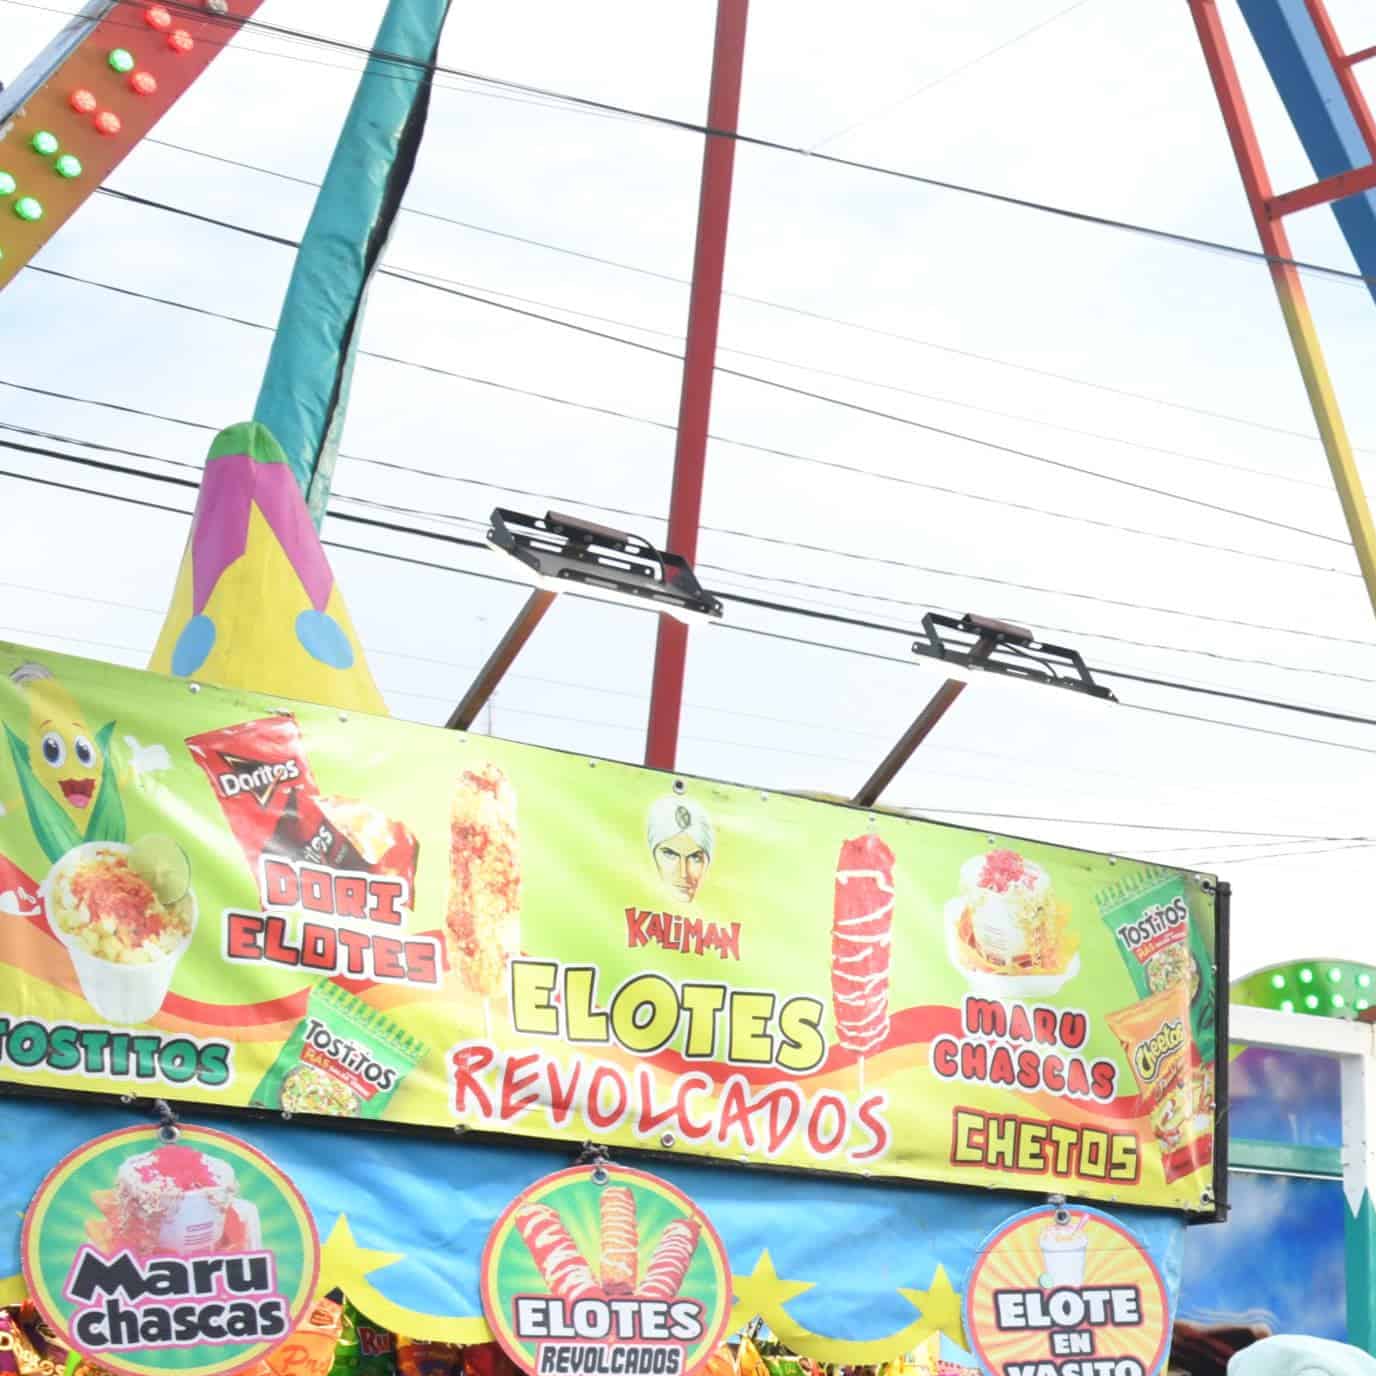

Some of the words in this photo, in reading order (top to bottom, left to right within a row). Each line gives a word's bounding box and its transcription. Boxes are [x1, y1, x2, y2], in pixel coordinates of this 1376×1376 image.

[219, 760, 299, 796] Doritos
[264, 860, 402, 925] DORI
[227, 913, 437, 984] ELOTES
[511, 960, 825, 1071] ELOTES
[966, 997, 1086, 1049] MARU
[934, 1039, 1116, 1099] CHASCAS
[453, 1046, 889, 1158] REVOLCADOS
[952, 1110, 1138, 1181] CHETOS
[71, 1251, 269, 1302] Maru
[77, 1299, 286, 1346] chascas
[516, 1297, 704, 1341] ELOTES
[995, 1287, 1141, 1330] ELOTE
[541, 1346, 680, 1374] REVOLCADOS
[1051, 1330, 1093, 1355] EN
